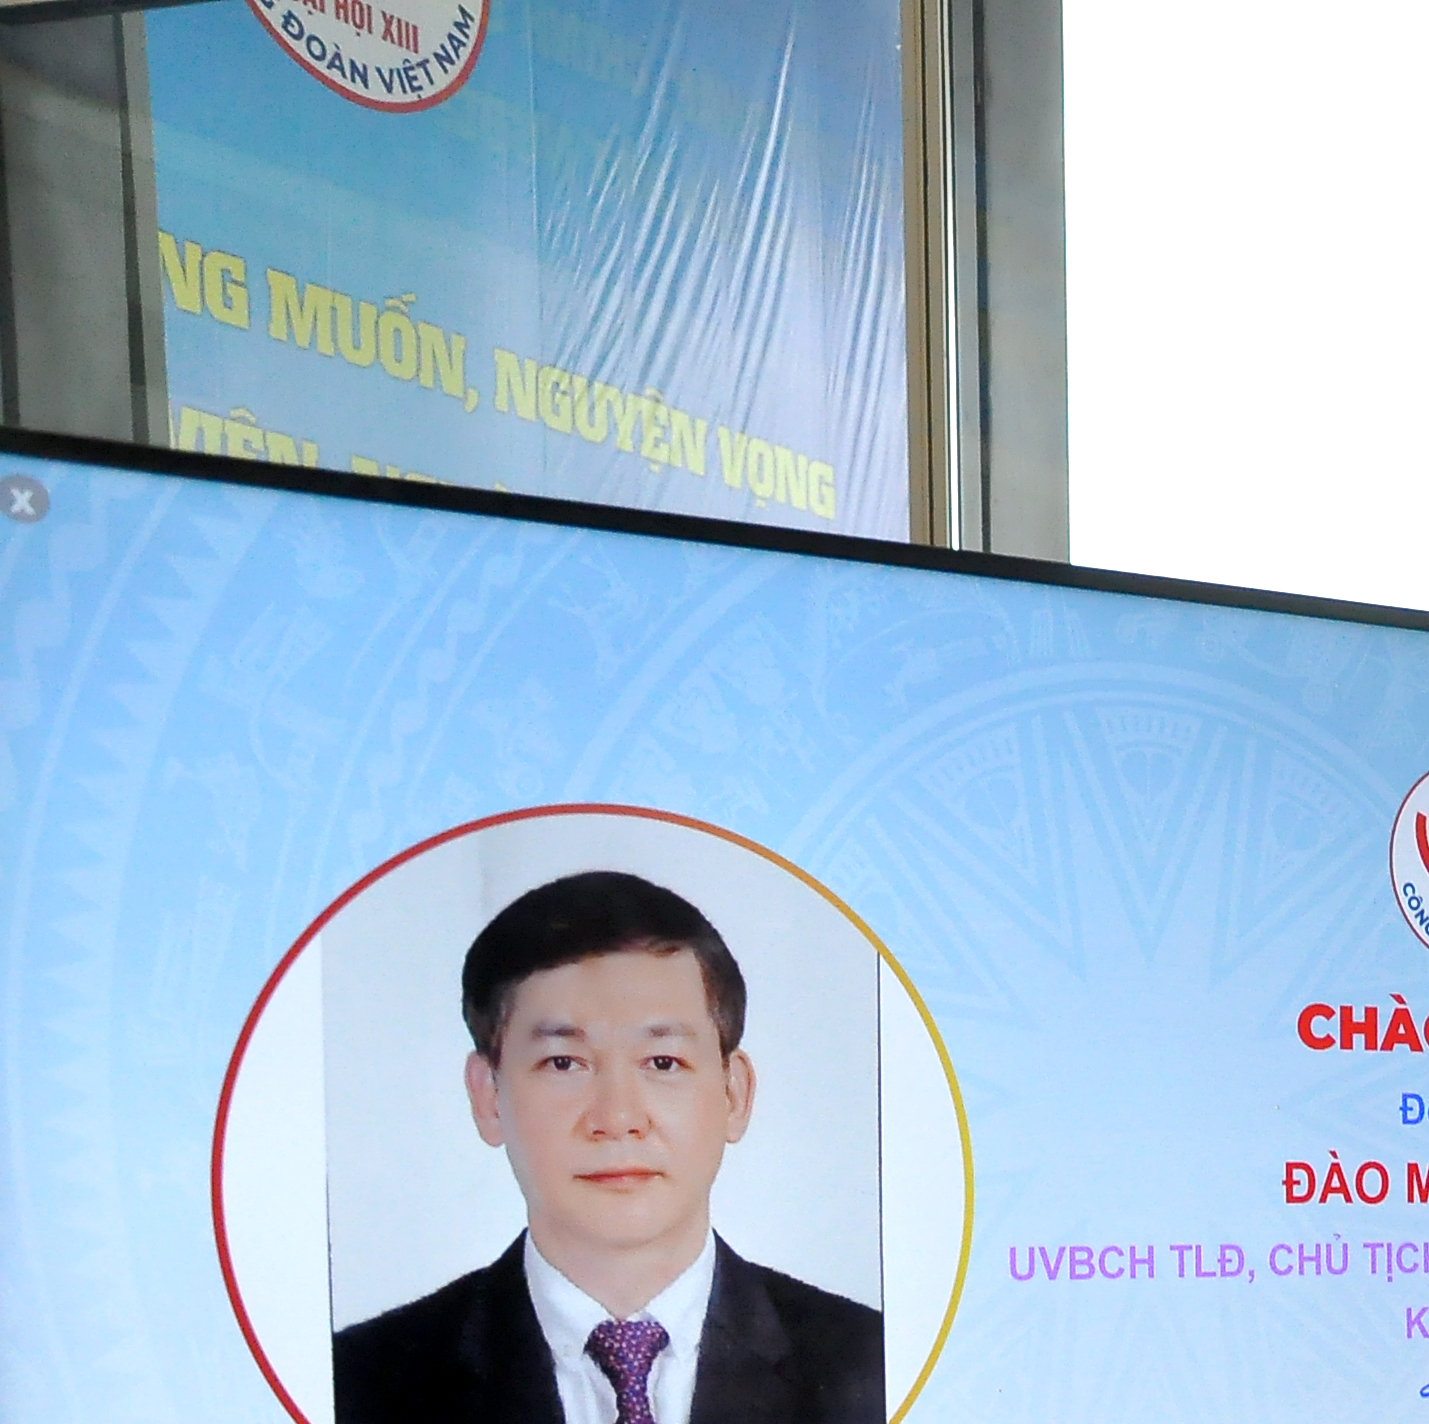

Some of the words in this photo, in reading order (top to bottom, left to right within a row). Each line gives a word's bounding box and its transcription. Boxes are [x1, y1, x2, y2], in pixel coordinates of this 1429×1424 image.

[281, 10, 370, 90] ĐOÀN
[376, 58, 435, 99] VIỆT
[433, 4, 476, 74] NAM
[381, 10, 420, 54] XIII
[266, 267, 479, 414] MUỐN,
[494, 347, 708, 478] NGUYỆN
[717, 425, 836, 520] VỌNG
[1282, 1150, 1390, 1205] ĐÀO
[1009, 1245, 1155, 1281] UVBCH
[1170, 1244, 1255, 1283] TLĐ,
[1269, 1233, 1350, 1276] CHỦ
